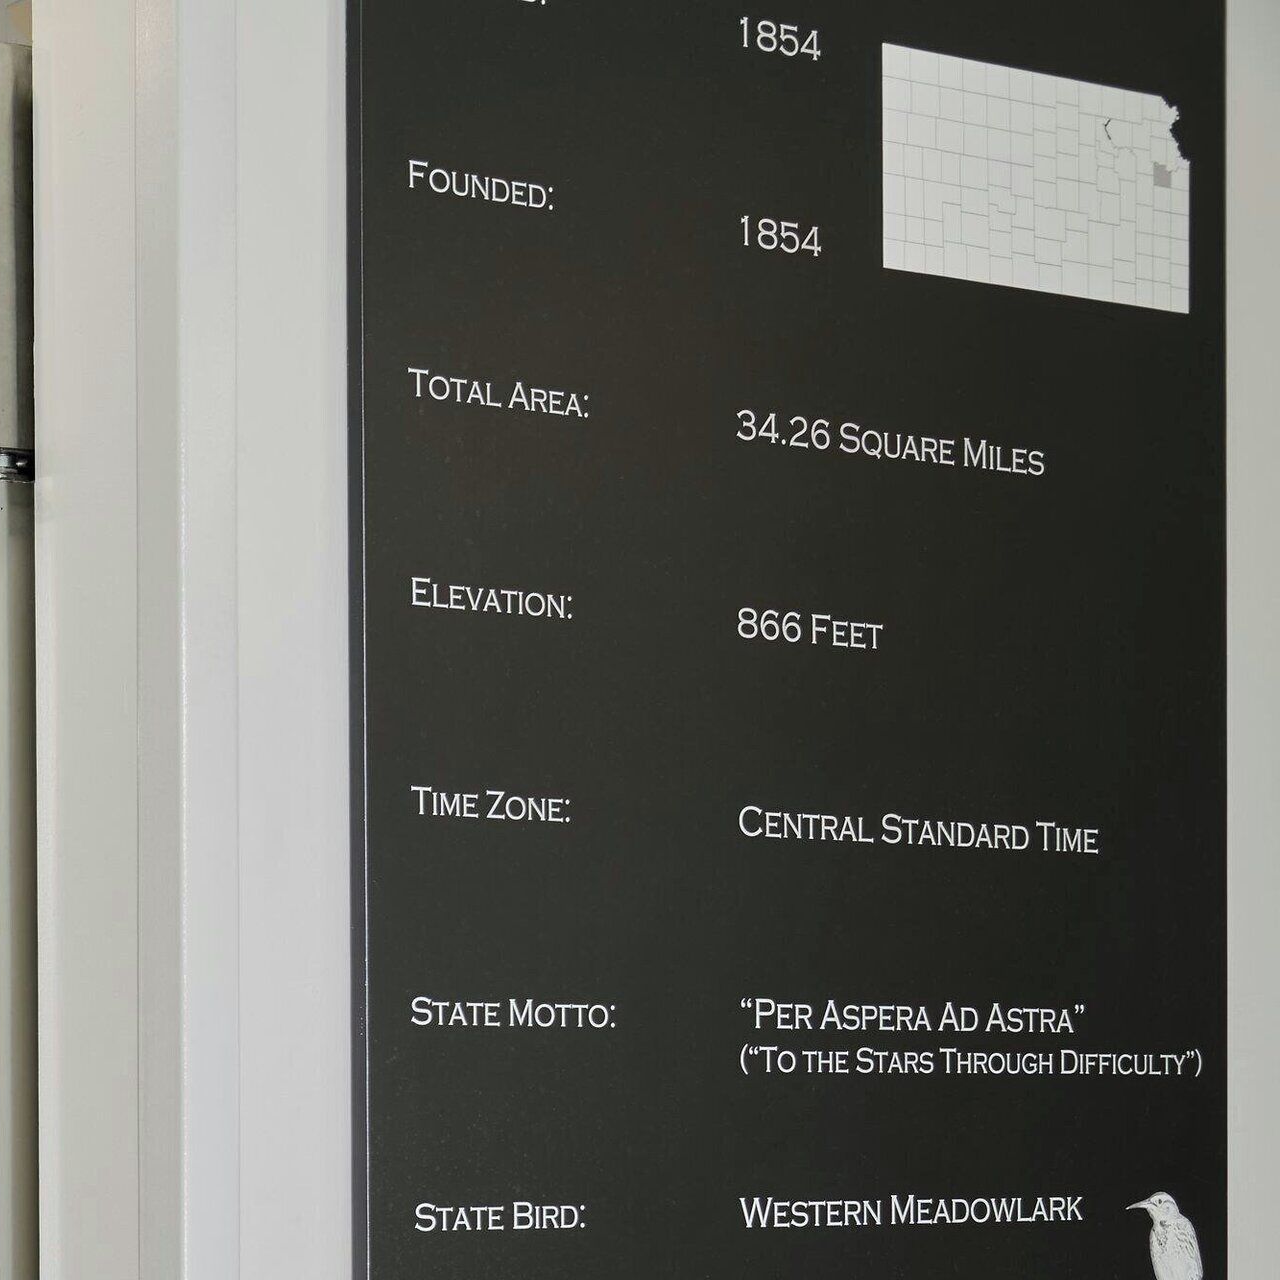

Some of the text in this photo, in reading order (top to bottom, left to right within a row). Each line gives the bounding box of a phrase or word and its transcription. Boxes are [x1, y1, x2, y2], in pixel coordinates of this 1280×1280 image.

[740, 17, 821, 60] 1854
[408, 160, 554, 211] FOUNDED:
[740, 216, 822, 257] 1854
[408, 367, 589, 419] TOTAL AREA:
[737, 410, 1045, 476] 34.26 SQUARE MILES
[411, 577, 573, 620] ELEVATION:
[738, 608, 884, 650] 866 FEET
[411, 786, 571, 823] TIME ZONE:
[739, 806, 1099, 854] CENTRAL STANDARD TIME
[411, 997, 616, 1029] STATE MOTTO:
[820, 1000, 931, 1031] ASPERA
[938, 1002, 978, 1031] AD
[803, 1050, 849, 1074] THE
[856, 1047, 934, 1074] STARS
[940, 1048, 1053, 1075] THROUGH
[415, 1202, 586, 1232] STATE BIRD:
[739, 1195, 1083, 1229] WESTERN MEADOWLARK
